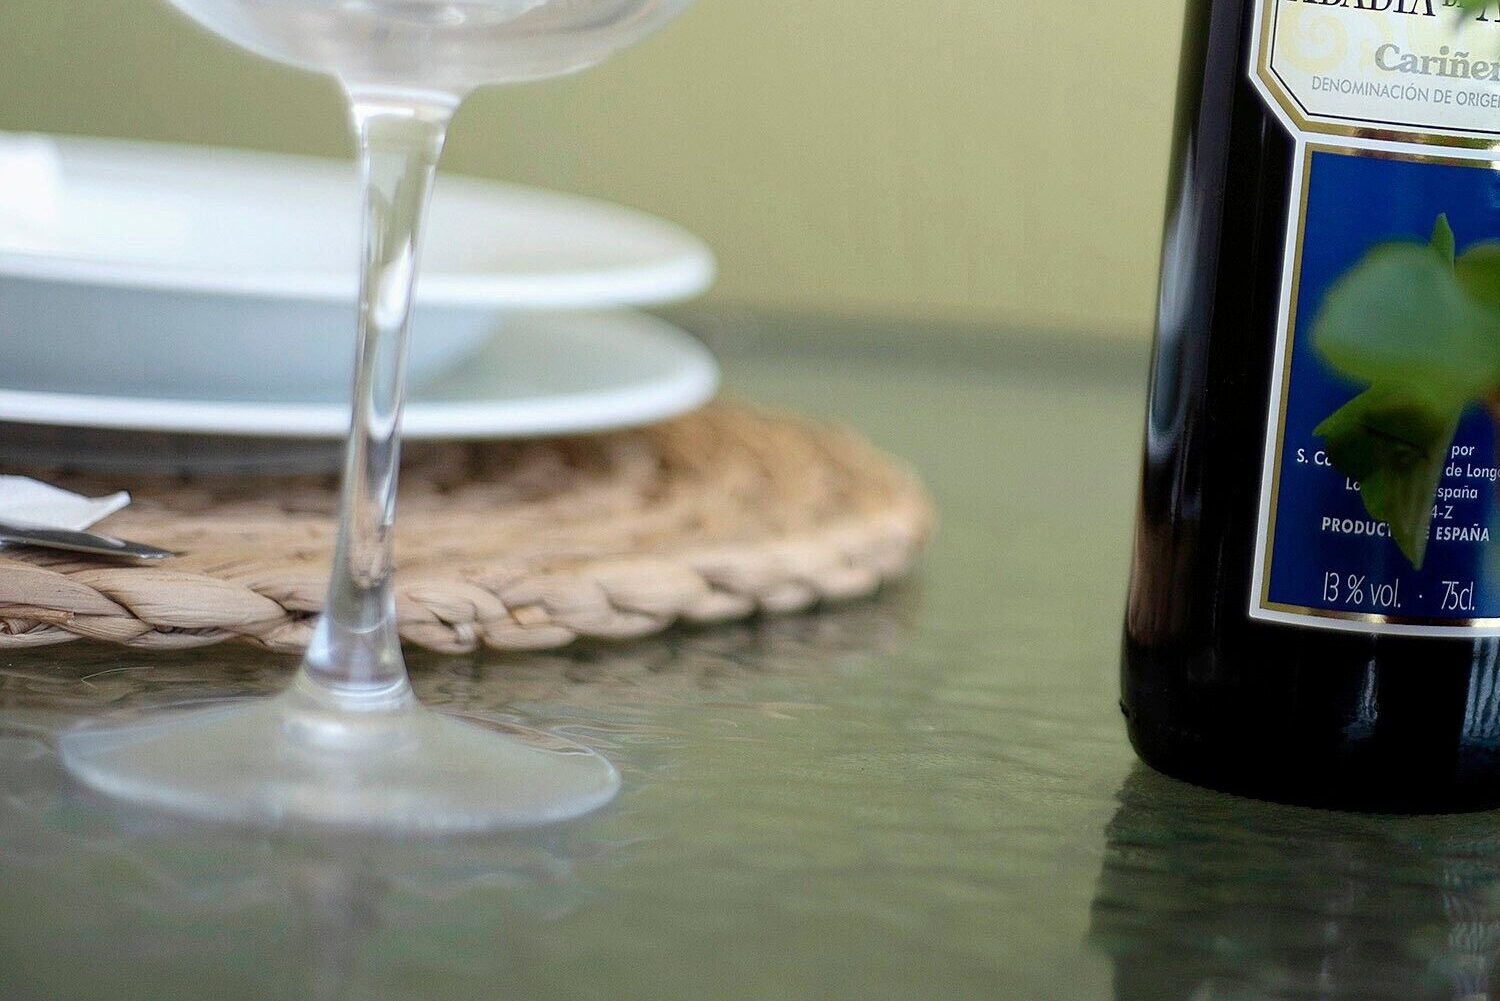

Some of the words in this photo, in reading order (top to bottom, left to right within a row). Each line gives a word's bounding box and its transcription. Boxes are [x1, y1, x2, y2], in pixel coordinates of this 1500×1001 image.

[1312, 75, 1429, 102] DENOMINACIÓN
[1433, 89, 1452, 104] DE
[1296, 448, 1310, 464] S.
[1445, 461, 1462, 477] de
[1451, 445, 1475, 459] por
[1434, 485, 1478, 502] spaña
[1435, 523, 1490, 541] ESPAÑA
[1323, 571, 1340, 602] 13
[1370, 578, 1401, 608] vol.
[1441, 581, 1475, 611] 75cl.
